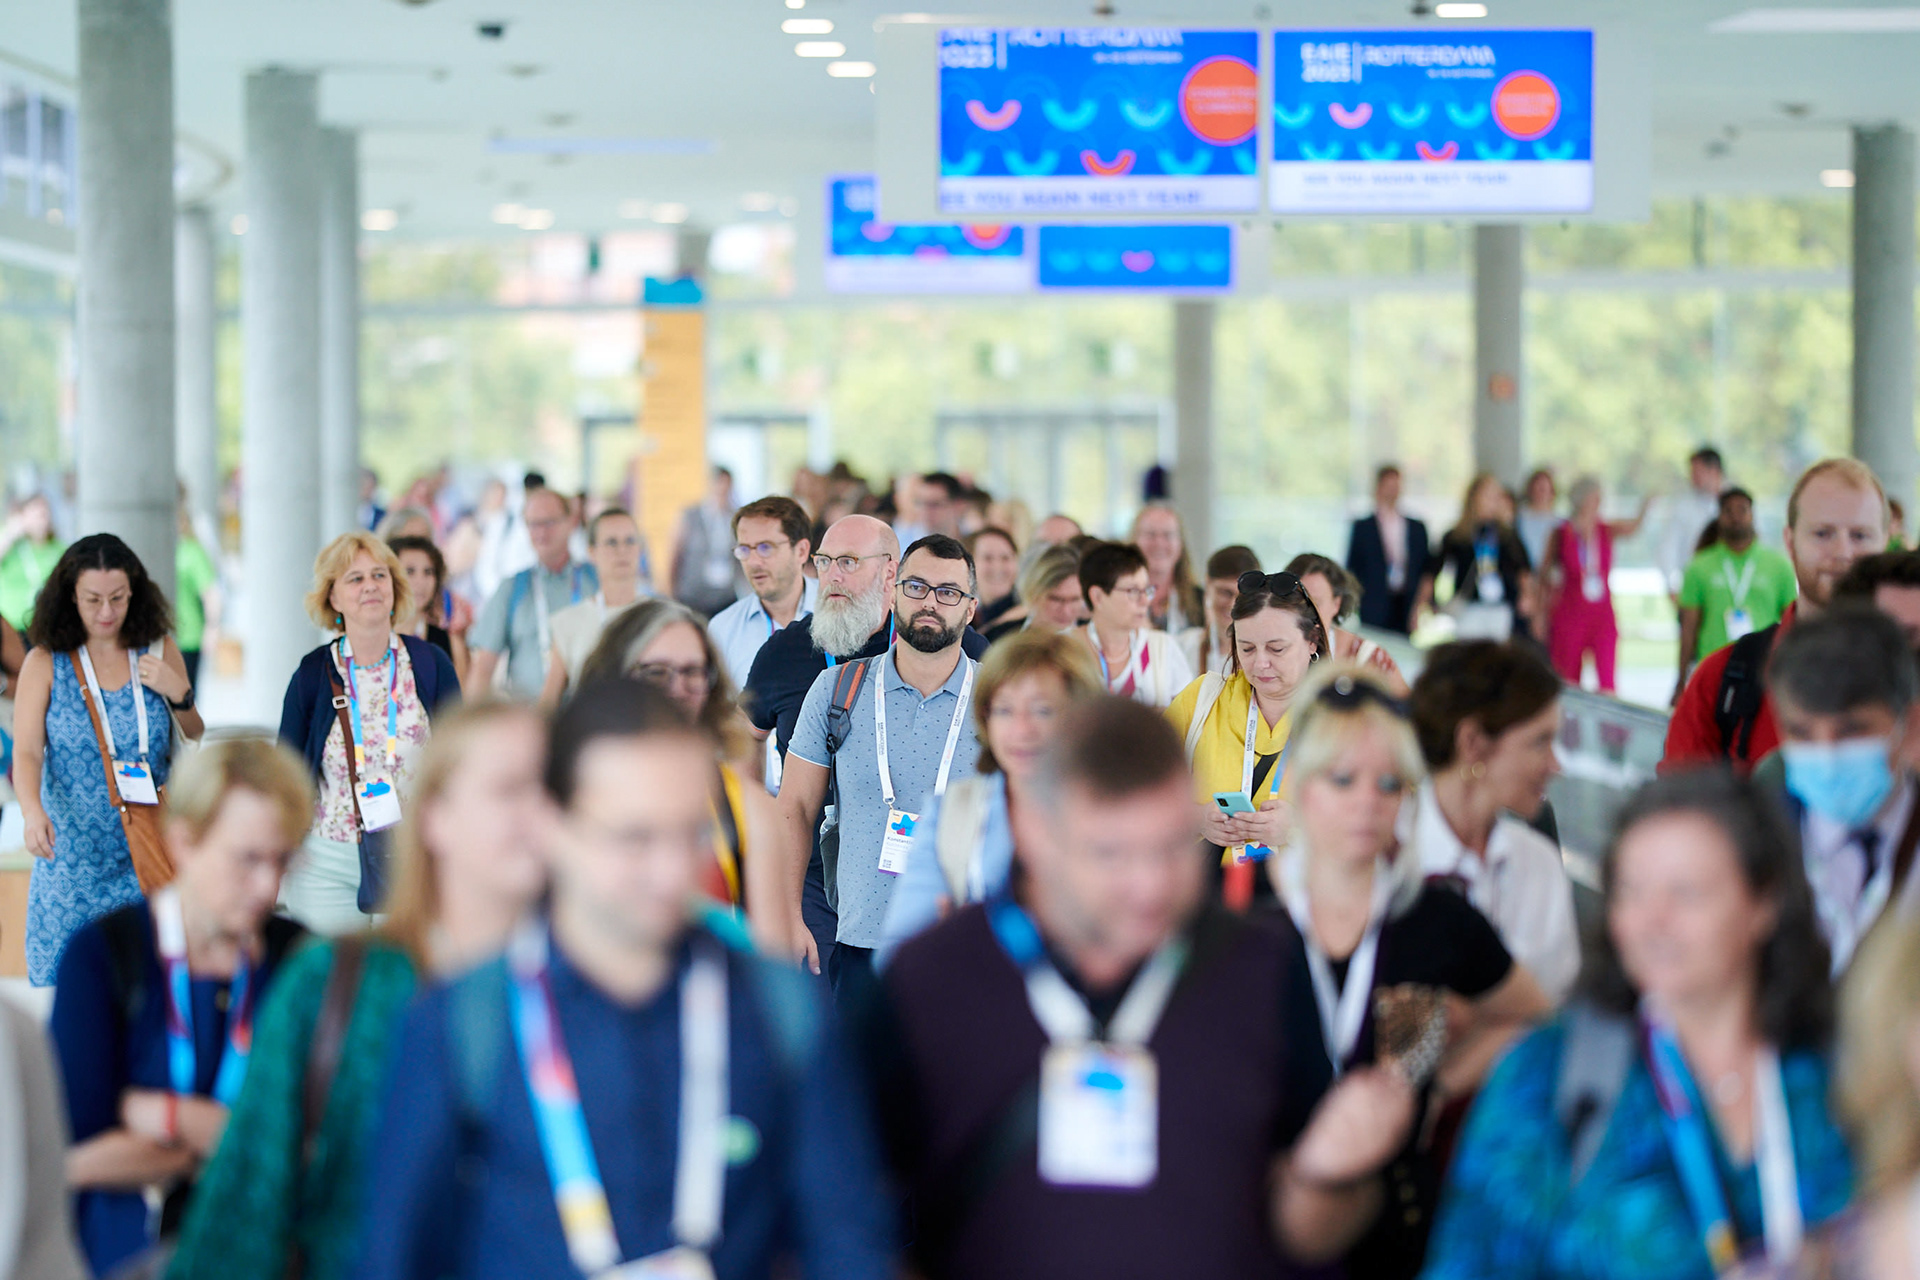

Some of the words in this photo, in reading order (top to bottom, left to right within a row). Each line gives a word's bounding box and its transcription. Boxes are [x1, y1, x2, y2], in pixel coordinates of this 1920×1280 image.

[1301, 42, 1350, 62] EAIE
[1364, 45, 1496, 67] ROTTERDAM
[974, 190, 1010, 205] YOU
[1022, 190, 1082, 205] AGAIN
[1089, 190, 1138, 205] NEXT
